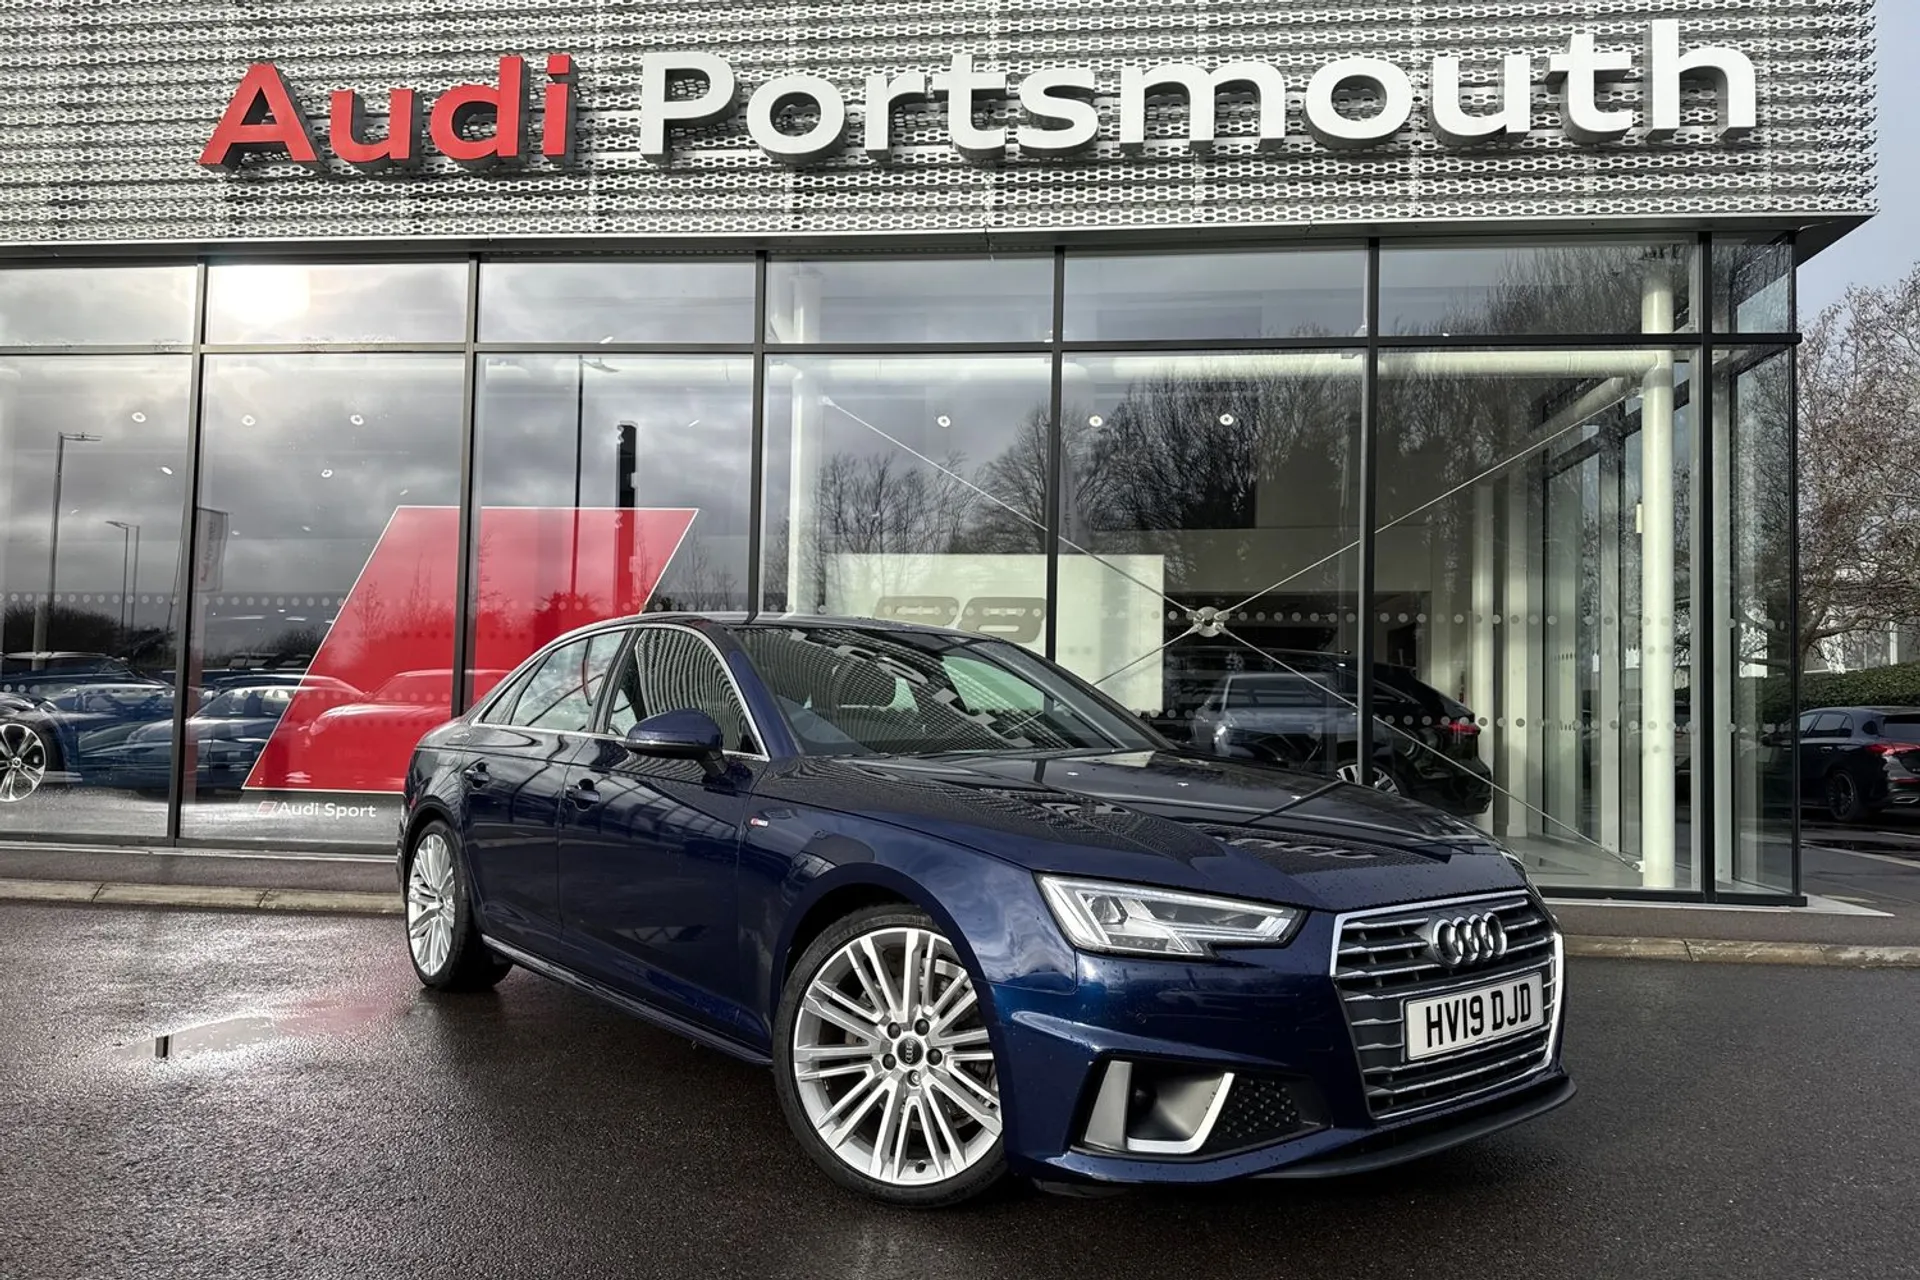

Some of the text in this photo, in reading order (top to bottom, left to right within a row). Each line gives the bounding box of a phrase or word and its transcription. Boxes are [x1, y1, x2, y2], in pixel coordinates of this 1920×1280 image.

[198, 18, 1757, 166] Audi Portsmouth
[276, 801, 377, 821] Audi Sport
[1426, 982, 1532, 1048] HV19 DJD
